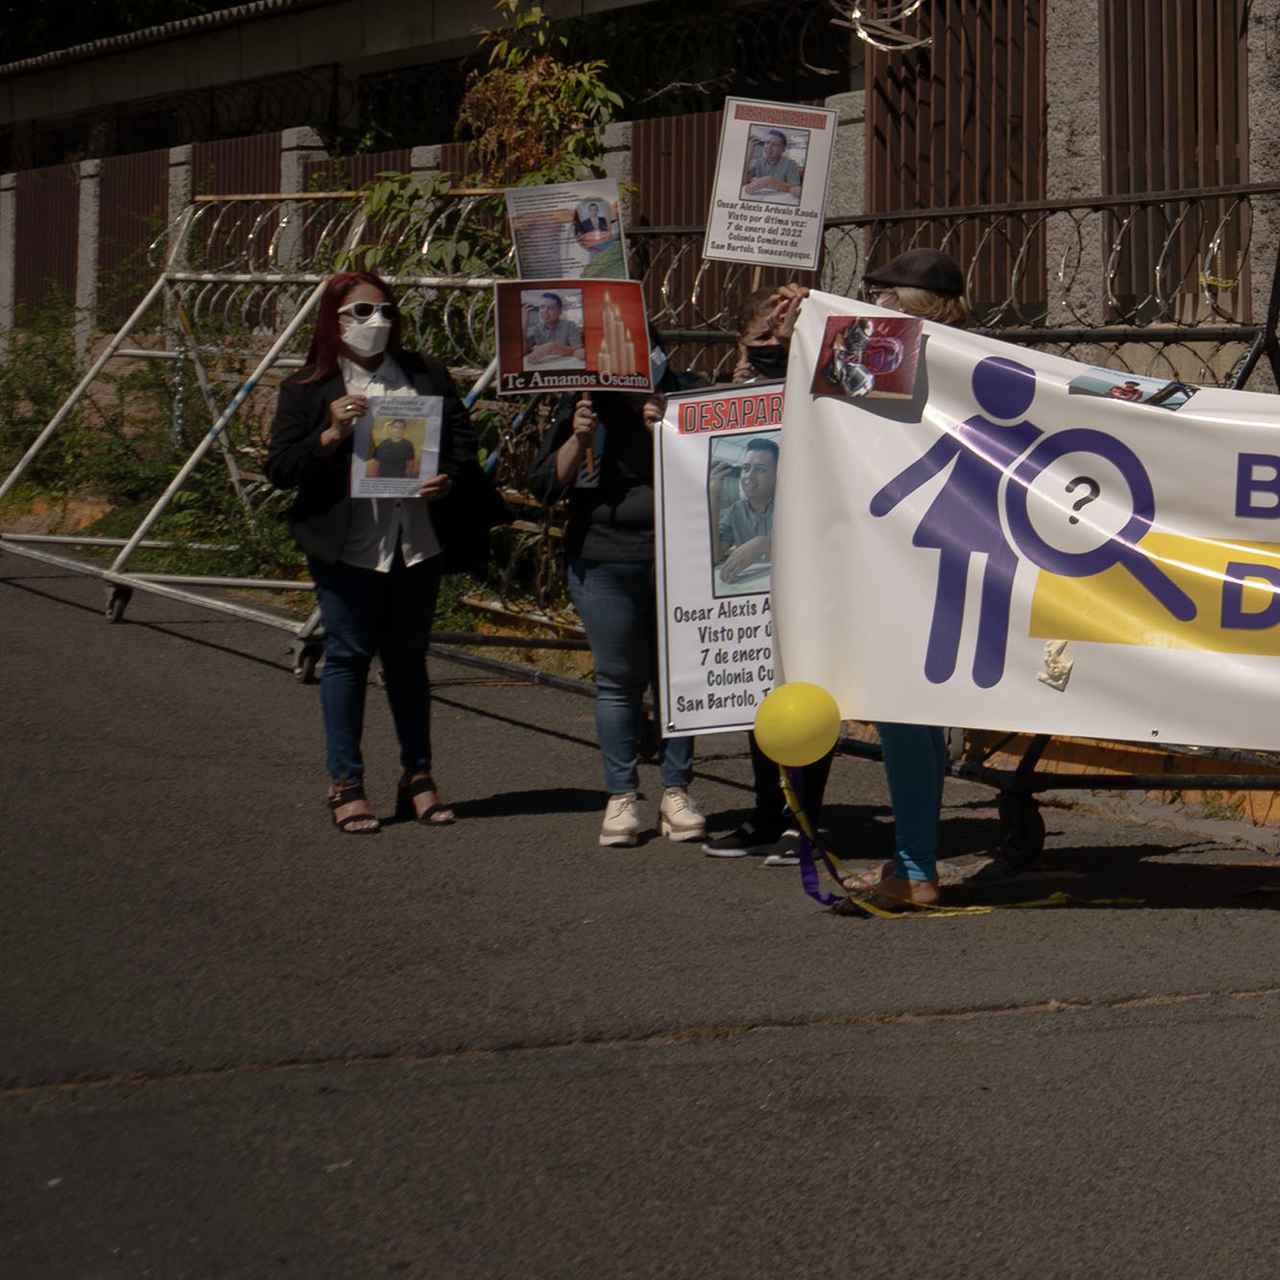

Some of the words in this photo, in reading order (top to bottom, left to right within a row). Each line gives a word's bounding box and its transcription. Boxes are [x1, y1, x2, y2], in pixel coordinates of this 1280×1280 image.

[503, 373, 525, 389] Te
[528, 372, 597, 388] Amamos
[600, 371, 650, 389] Oscarito
[674, 606, 715, 623] Oscar
[718, 602, 758, 620] Alexis
[697, 624, 734, 644] Visto
[738, 625, 760, 645] por
[700, 649, 710, 667] 7
[714, 647, 729, 664] de
[732, 646, 772, 663] enero
[706, 667, 754, 687] Colonia
[676, 694, 704, 714] San
[707, 690, 759, 712] Bartolo,
